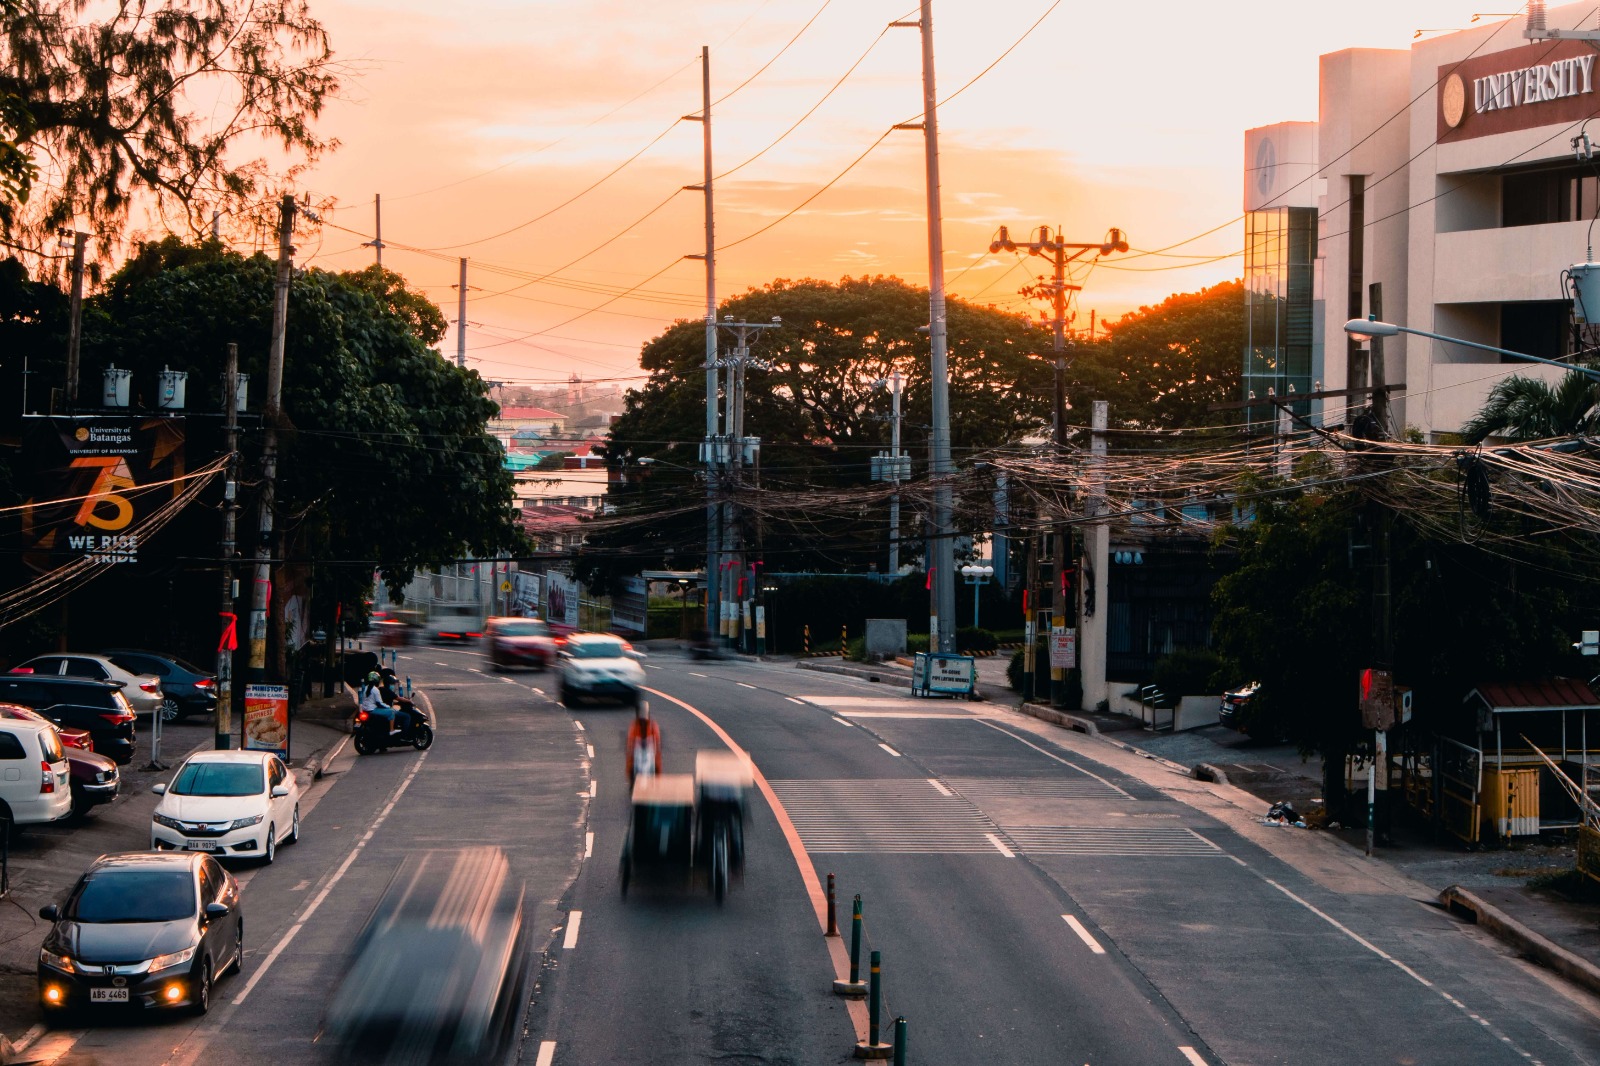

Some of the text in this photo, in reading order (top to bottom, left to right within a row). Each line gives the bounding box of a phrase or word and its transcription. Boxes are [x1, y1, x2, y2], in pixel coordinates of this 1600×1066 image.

[1474, 54, 1597, 114] UNIVERSITY
[90, 427, 122, 435] University
[90, 433, 131, 444] Batangas
[69, 536, 138, 550] WE RISE
[247, 704, 263, 713] BUCKET
[247, 708, 273, 720] HAPPINESS
[92, 990, 127, 999] ABS 4469
